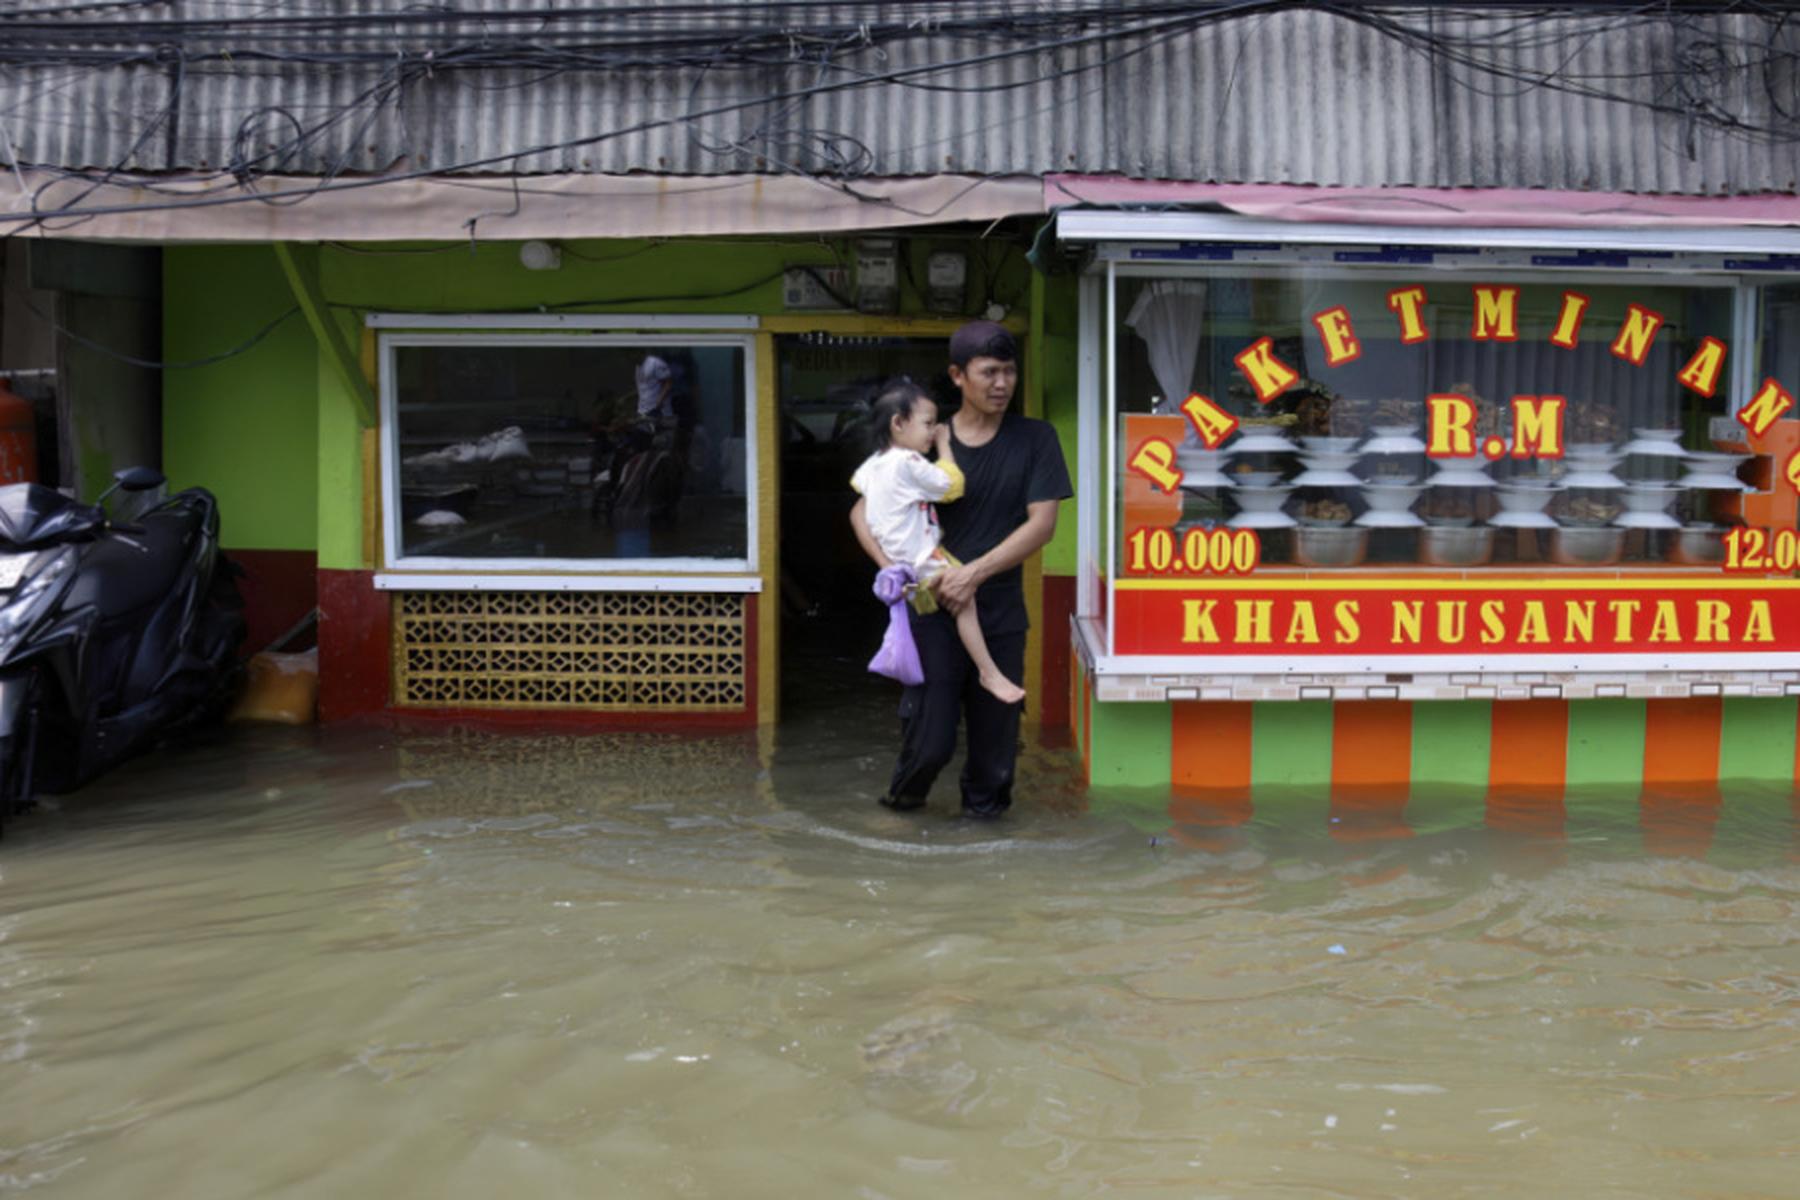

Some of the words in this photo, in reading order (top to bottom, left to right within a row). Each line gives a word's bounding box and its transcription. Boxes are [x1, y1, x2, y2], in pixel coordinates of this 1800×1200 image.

[1131, 288, 1425, 492] PAKET
[1428, 396, 1562, 456] R.M
[1130, 529, 1258, 572] 10.000
[1182, 599, 1361, 644] KHAS
[1391, 599, 1774, 644] NUSANTARA
